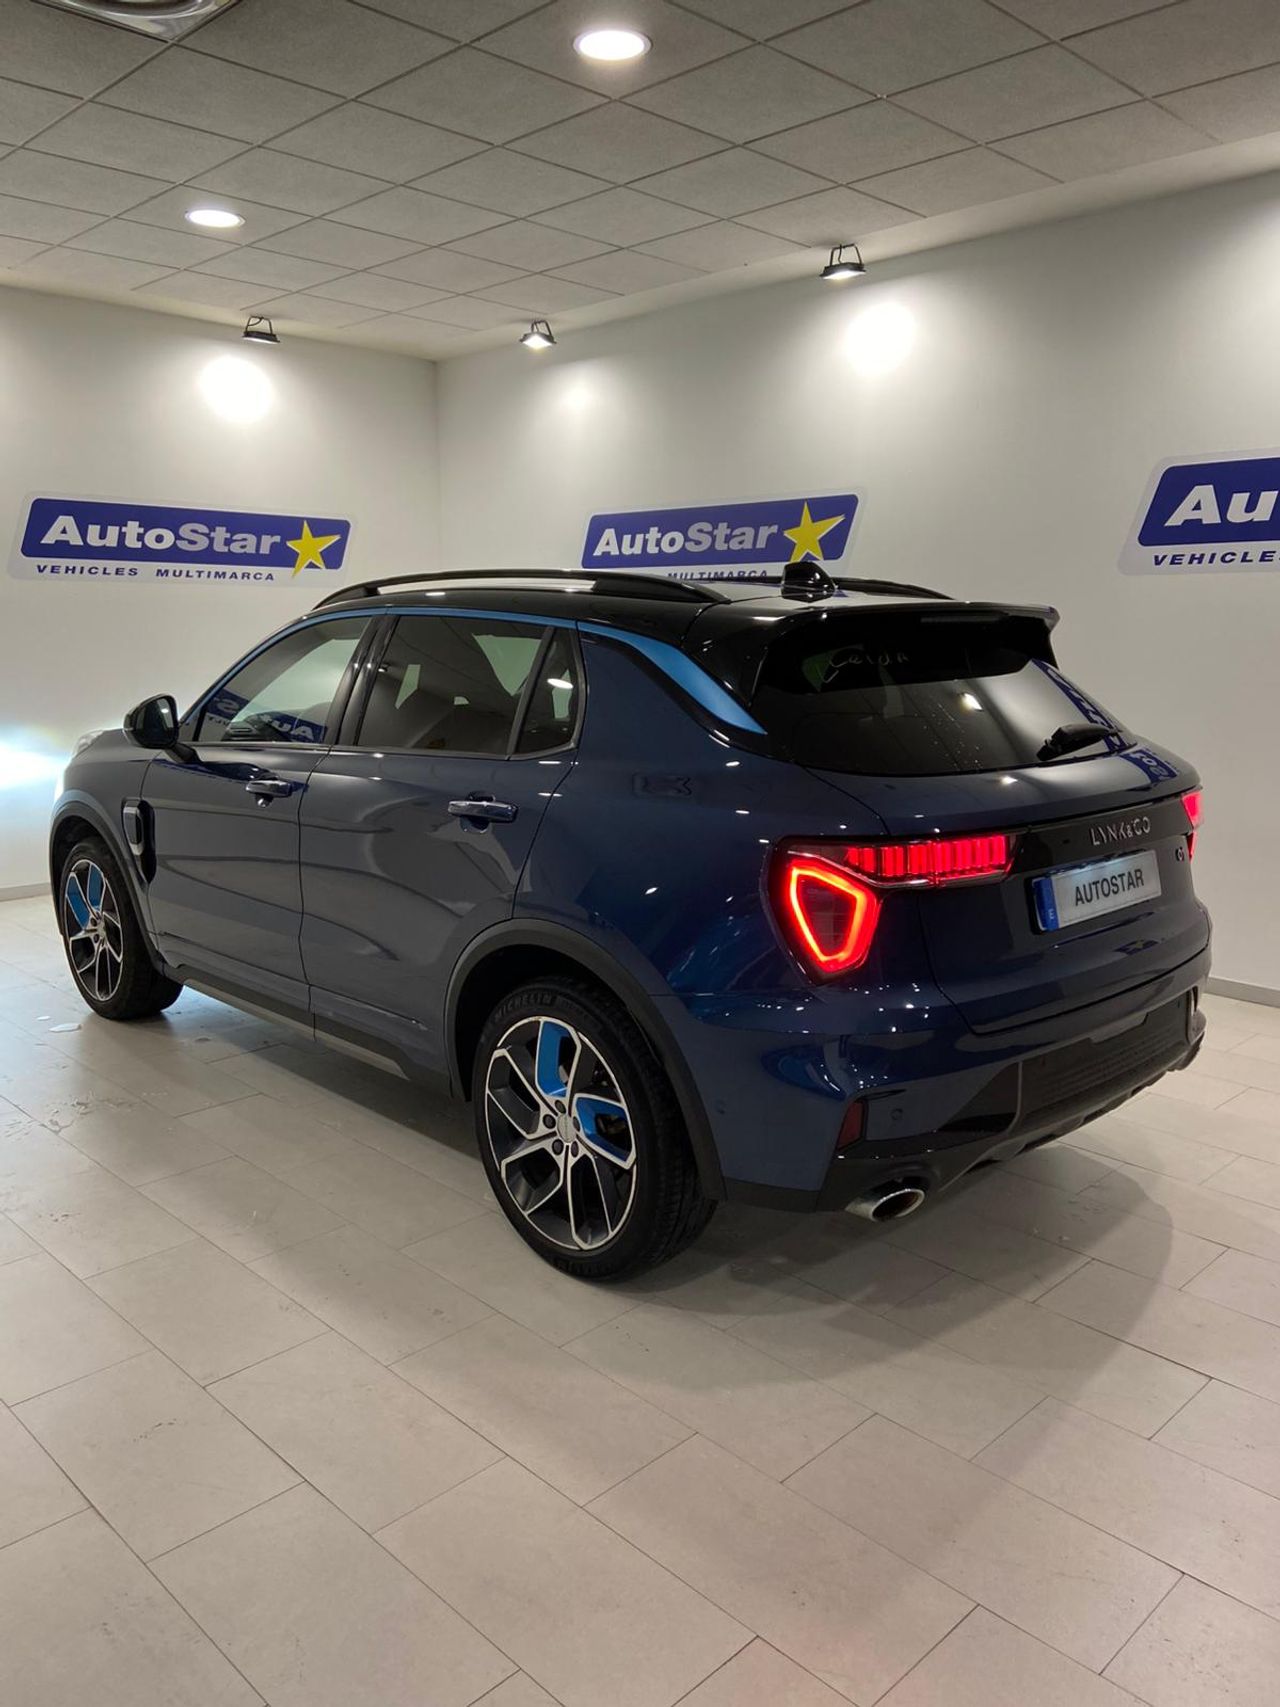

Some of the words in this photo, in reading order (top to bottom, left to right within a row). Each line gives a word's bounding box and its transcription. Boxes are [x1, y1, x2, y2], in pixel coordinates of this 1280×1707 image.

[39, 515, 281, 554] AutoStar
[593, 521, 779, 556] AutoStar
[36, 564, 139, 577] VEHICLES
[155, 568, 275, 582] MULTIMARCA
[1153, 550, 1280, 566] VEHICLE
[1074, 868, 1145, 907] AUTOSTAR
